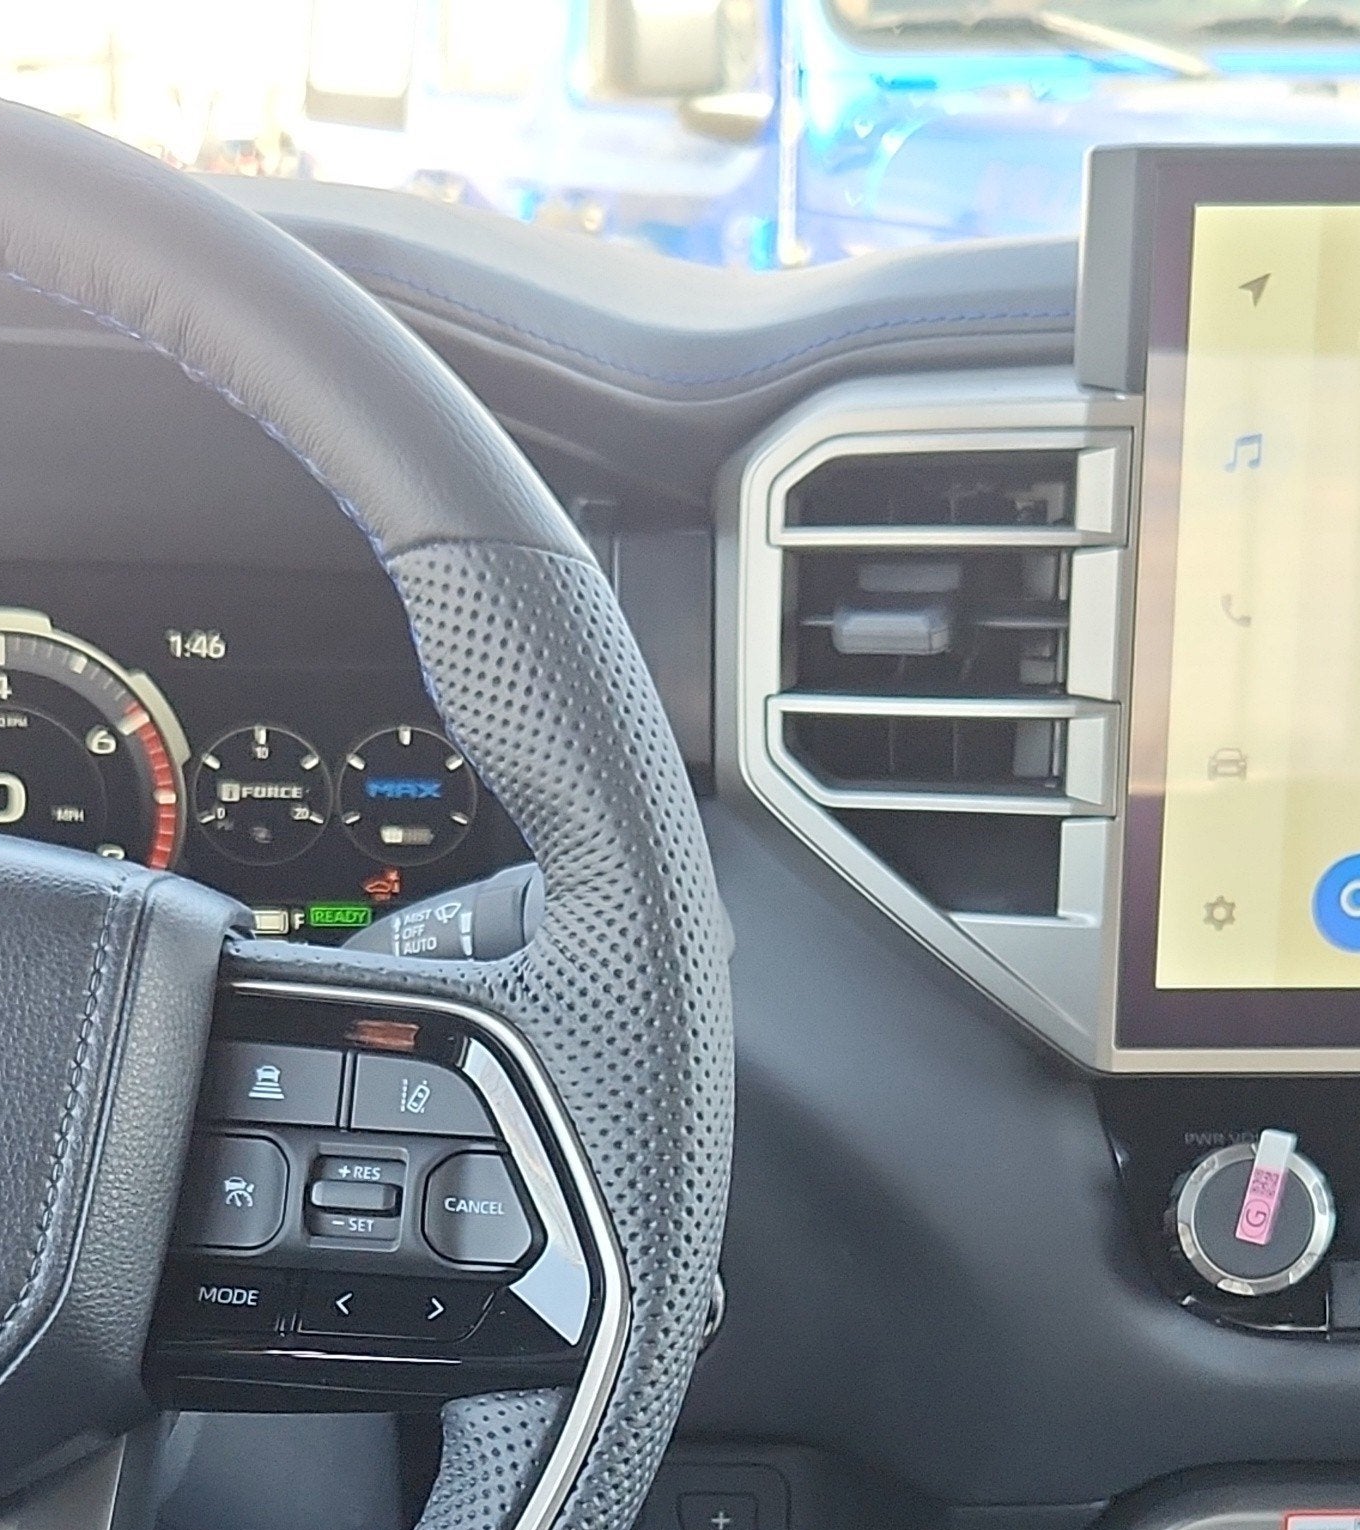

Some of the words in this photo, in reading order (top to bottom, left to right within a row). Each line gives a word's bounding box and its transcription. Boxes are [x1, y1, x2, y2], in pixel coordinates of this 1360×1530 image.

[166, 631, 227, 659] 1:46
[85, 725, 117, 754] 6
[363, 779, 442, 799] MAX
[293, 911, 306, 931] F
[313, 910, 367, 925] READY
[402, 924, 425, 940] OFF
[403, 937, 438, 955] AUTO
[353, 1165, 381, 1181] RES
[443, 1196, 506, 1217] CANCEL
[348, 1217, 375, 1234] SET
[198, 1286, 260, 1307] MODE
